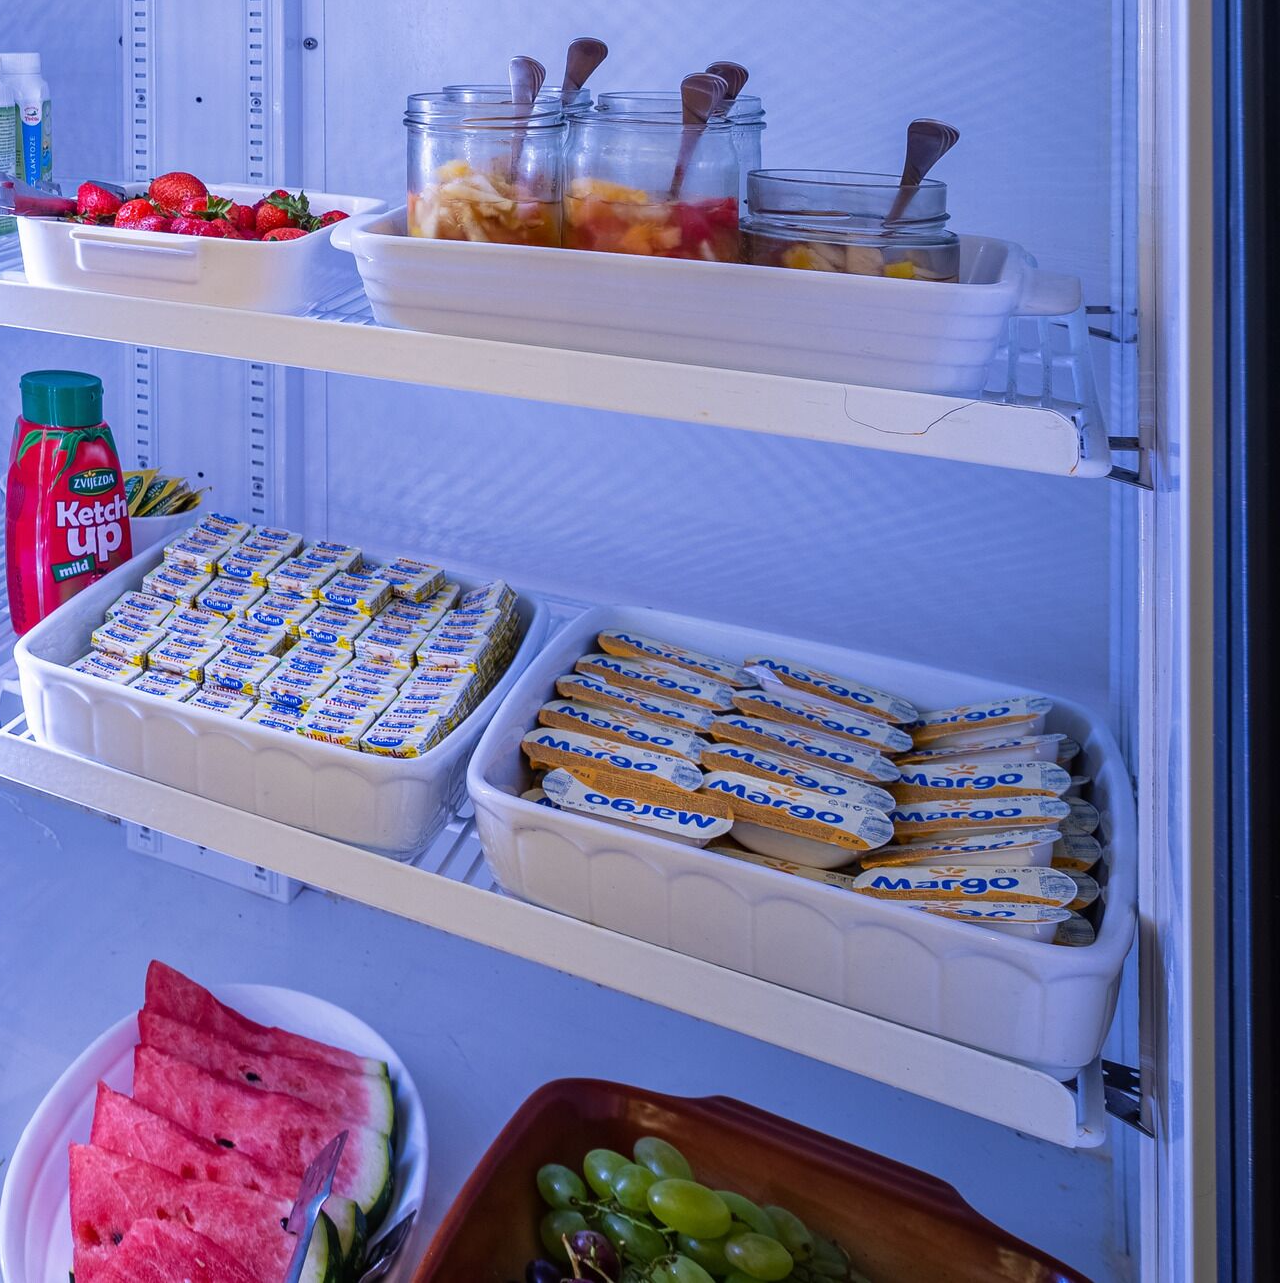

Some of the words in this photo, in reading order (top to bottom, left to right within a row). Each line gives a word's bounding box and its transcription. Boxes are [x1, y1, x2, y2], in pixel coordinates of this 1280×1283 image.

[29, 135, 37, 175] LAKTOZE
[73, 473, 115, 490] ZVIJEZDA
[56, 494, 129, 528] Ketch
[66, 521, 123, 563] up
[58, 559, 90, 578] mild
[226, 565, 250, 576] Dukat
[205, 599, 230, 609] Dukat
[329, 593, 354, 604] Dukat
[256, 613, 280, 624] Dukat
[309, 630, 335, 642] Dukat
[614, 633, 721, 672] Margo
[591, 657, 702, 696] Margo
[757, 659, 875, 704] Margo
[272, 692, 300, 706] Dukat
[573, 676, 686, 720] Margo
[749, 694, 871, 738] Margo
[305, 731, 345, 746] maslac
[556, 705, 675, 747] Margo
[728, 718, 855, 765] Margo
[536, 734, 658, 773] Margo
[718, 747, 848, 797] Margo
[899, 772, 1024, 790] Margo
[583, 792, 717, 830] Margo
[707, 778, 845, 826] Margo
[891, 807, 1023, 824] Margo
[870, 875, 1020, 895] Margo
